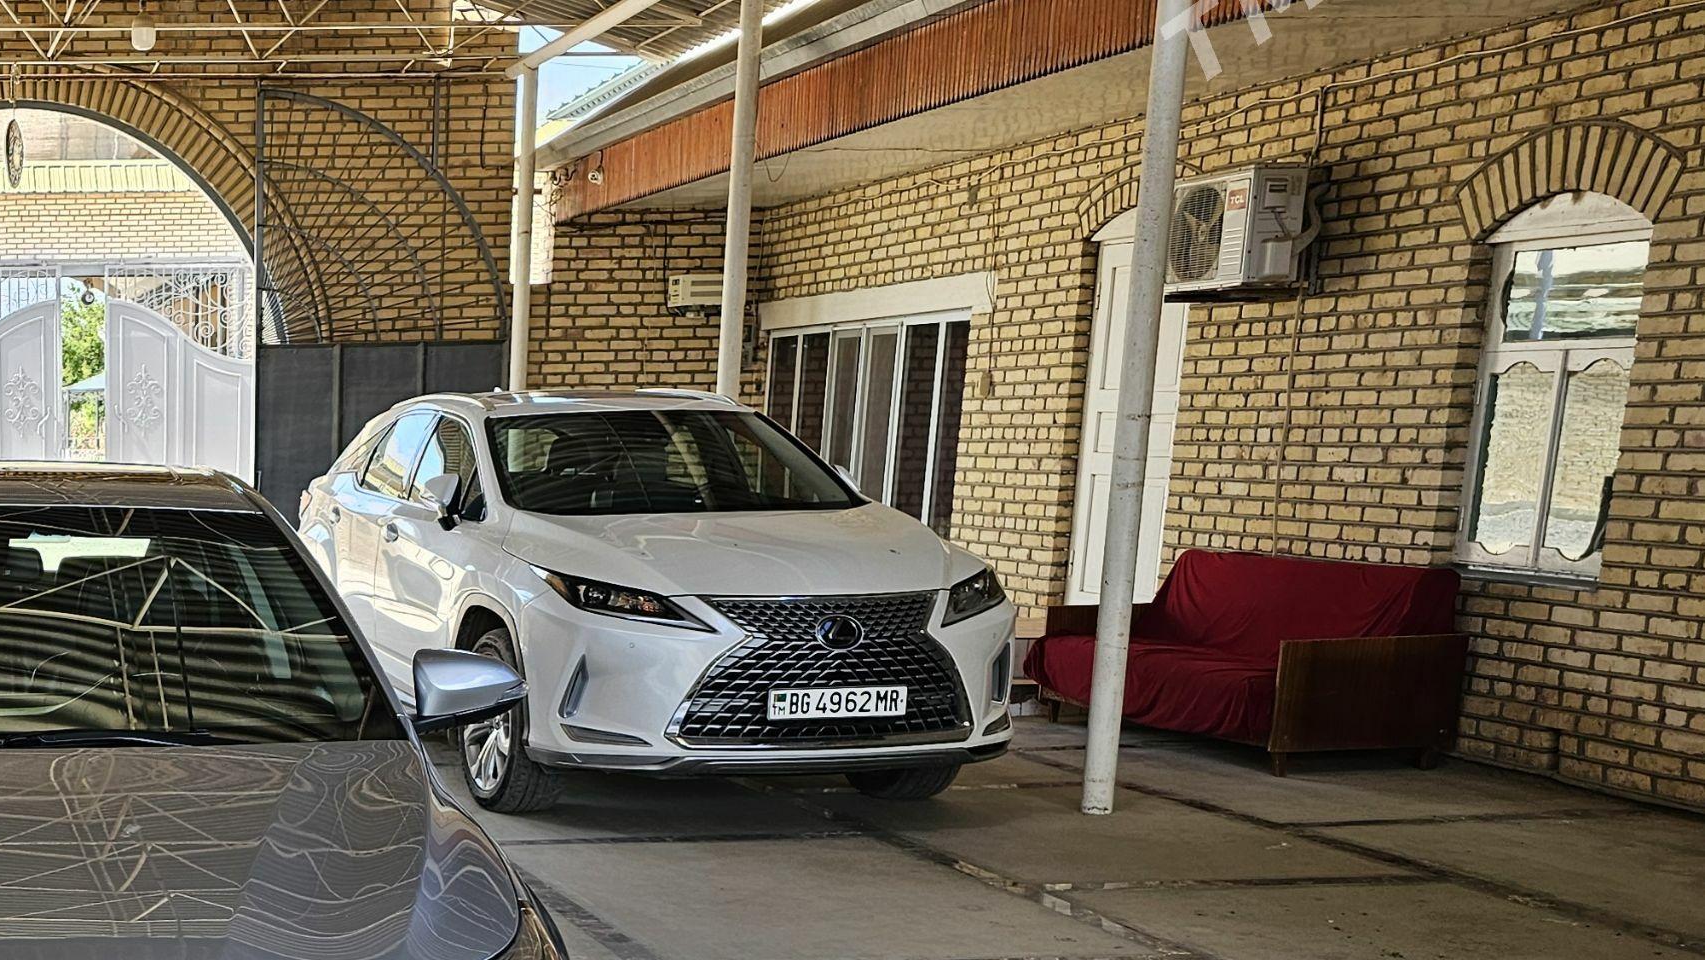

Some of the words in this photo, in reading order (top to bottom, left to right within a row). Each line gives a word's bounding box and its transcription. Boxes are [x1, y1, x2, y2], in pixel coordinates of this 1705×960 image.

[1230, 195, 1244, 204] TCL
[789, 692, 811, 714] BG
[815, 690, 871, 714] 4962
[875, 689, 899, 712] MR
[773, 704, 786, 715] TM
